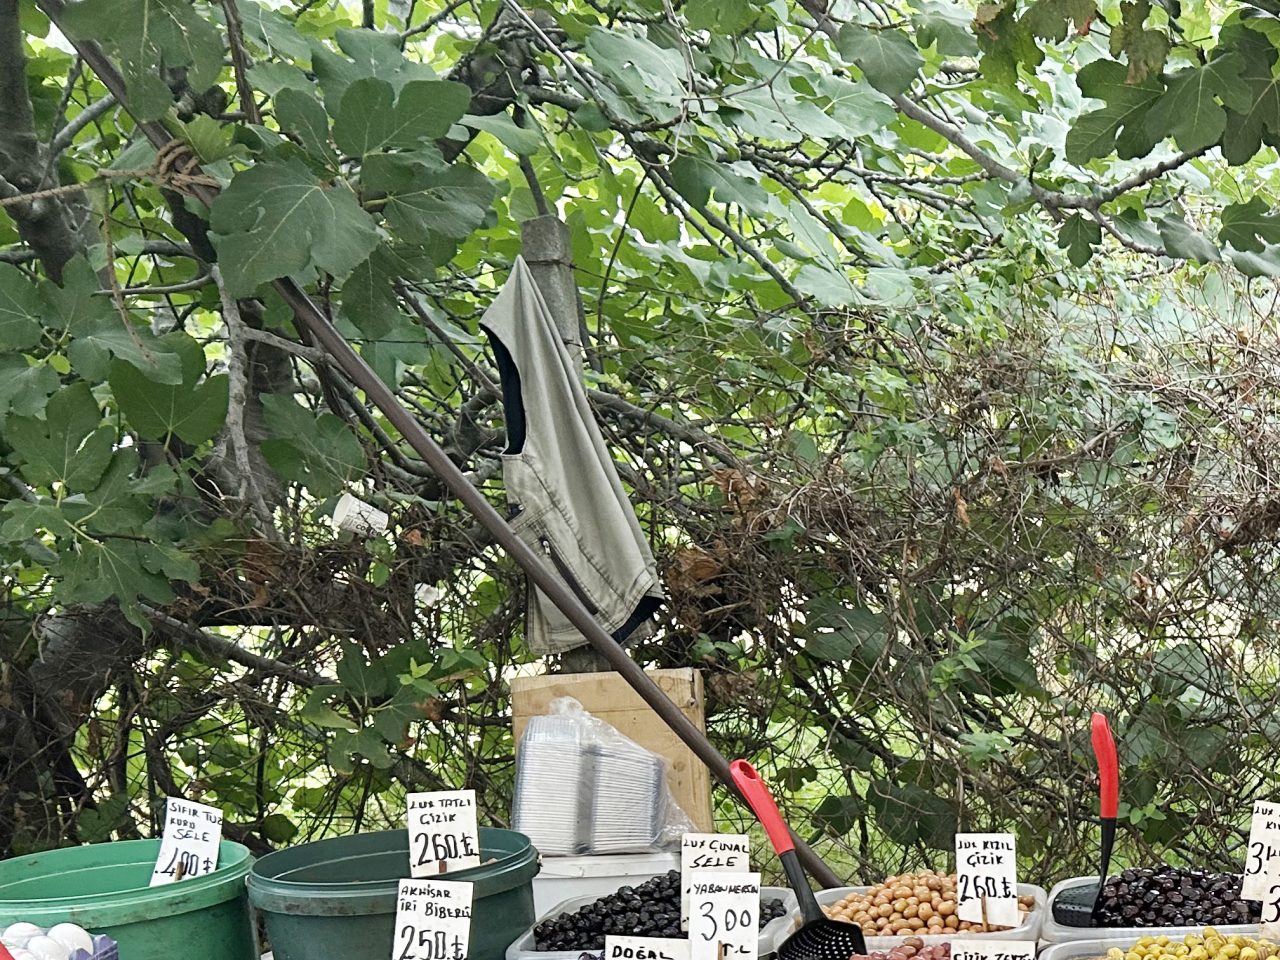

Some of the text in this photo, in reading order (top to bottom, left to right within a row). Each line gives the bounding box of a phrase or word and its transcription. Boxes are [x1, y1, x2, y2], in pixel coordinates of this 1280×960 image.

[173, 829, 210, 842] SELE
[689, 854, 738, 868] SELE
[967, 851, 1003, 867] ÇİZİK
[700, 901, 752, 941] 300
[612, 945, 674, 960] DOĞAL
